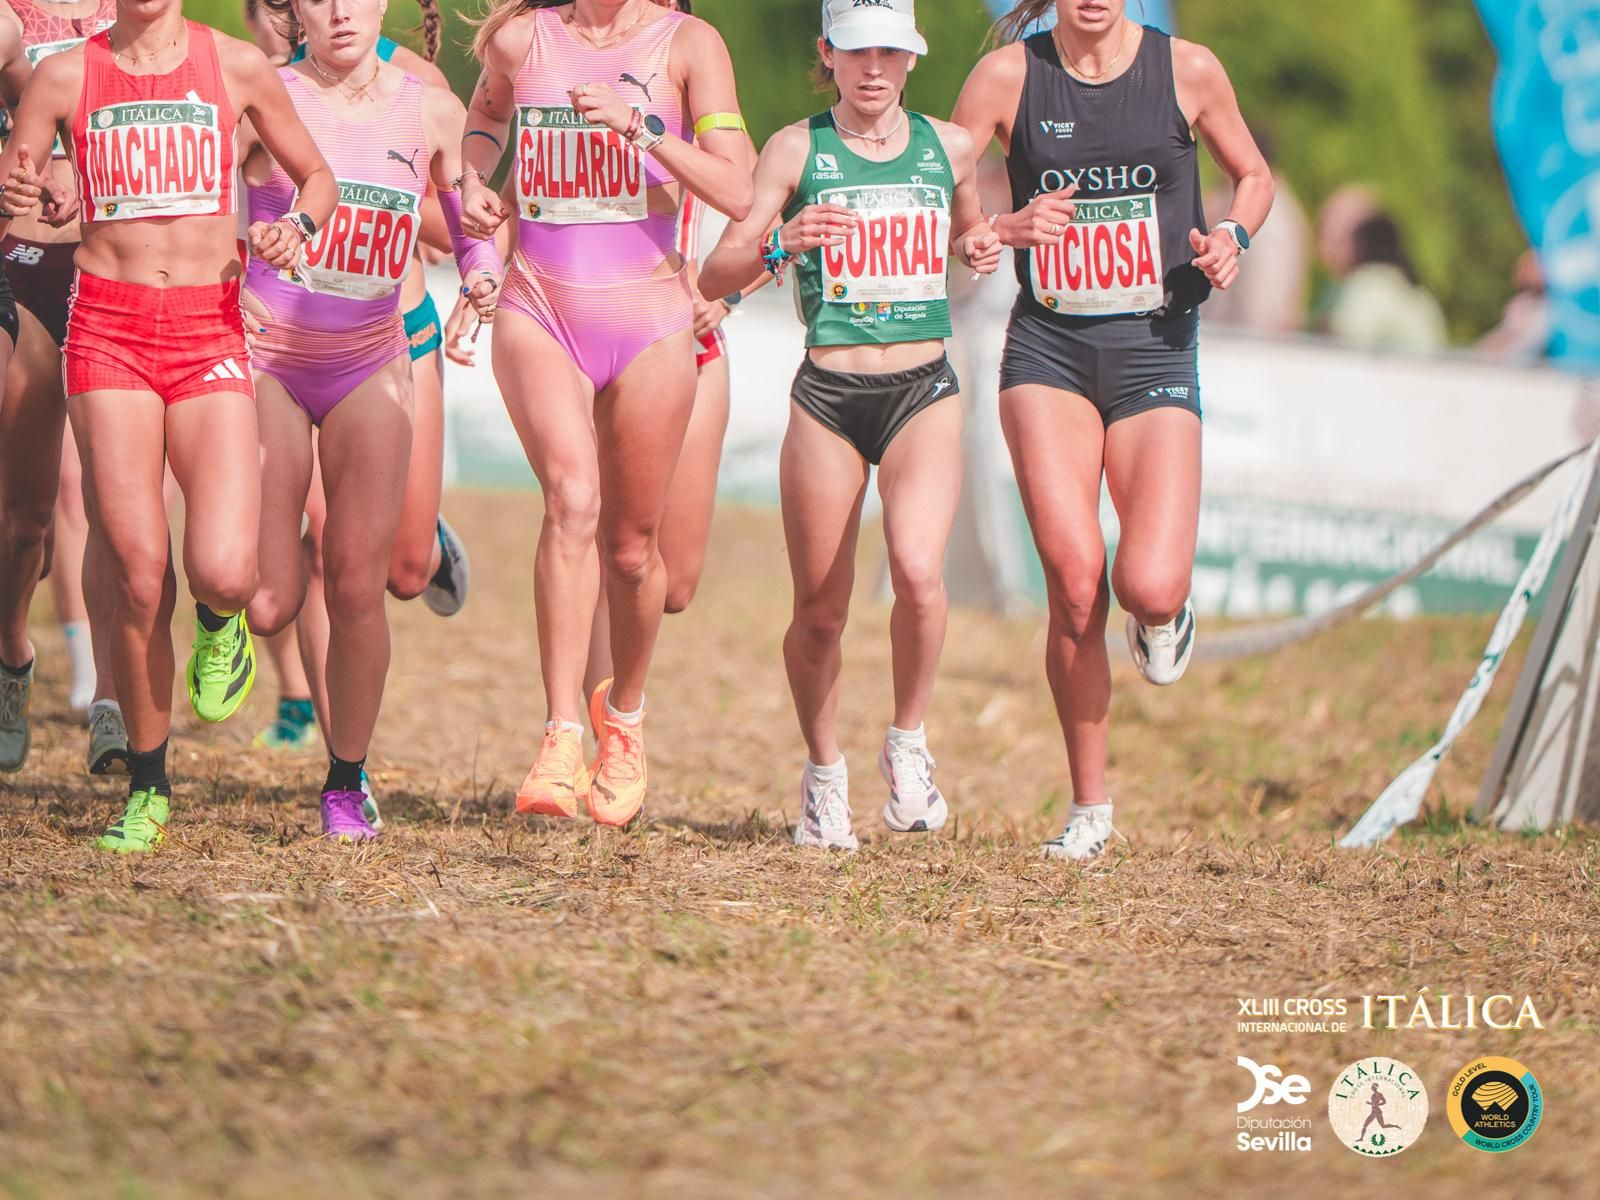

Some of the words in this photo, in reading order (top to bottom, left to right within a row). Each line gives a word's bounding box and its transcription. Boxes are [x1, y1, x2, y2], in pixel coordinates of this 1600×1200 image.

[121, 104, 184, 122] ITÁLICA
[88, 125, 216, 197] MACHADO
[338, 184, 390, 206] TÁLICA
[520, 128, 640, 199] GALLARDO
[1040, 164, 1157, 194] OYSHO
[823, 210, 944, 279] CORRAL
[1035, 220, 1157, 292] VICIOSA
